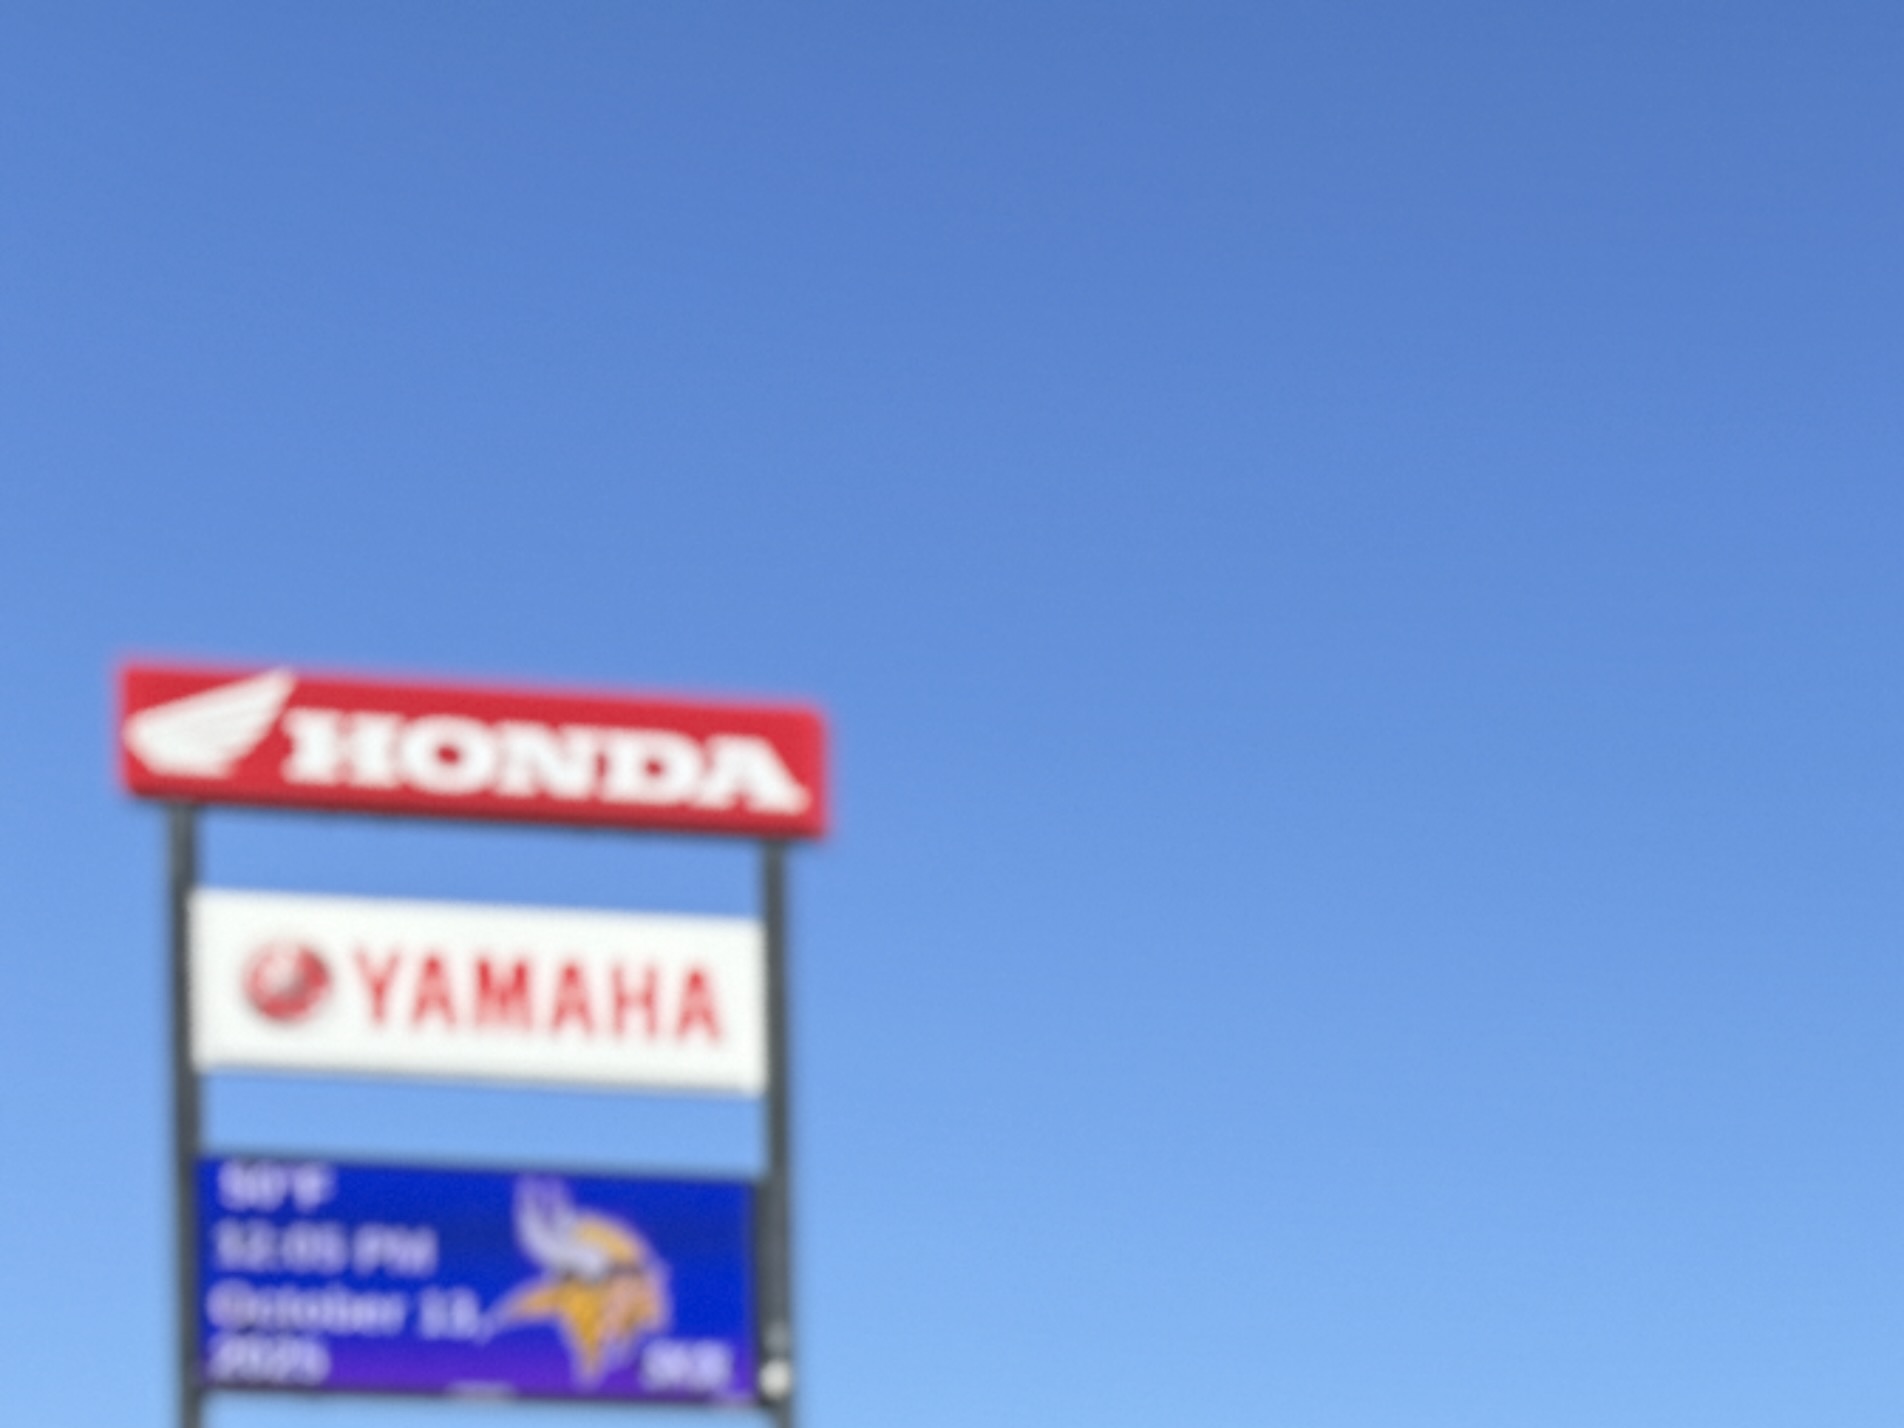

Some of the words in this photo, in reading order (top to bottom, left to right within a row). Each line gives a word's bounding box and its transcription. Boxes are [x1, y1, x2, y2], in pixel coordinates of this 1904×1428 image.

[281, 706, 811, 815] HONDA
[354, 947, 722, 1045] YAMAHA
[352, 1223, 439, 1278] PM
[206, 1279, 405, 1337] October
